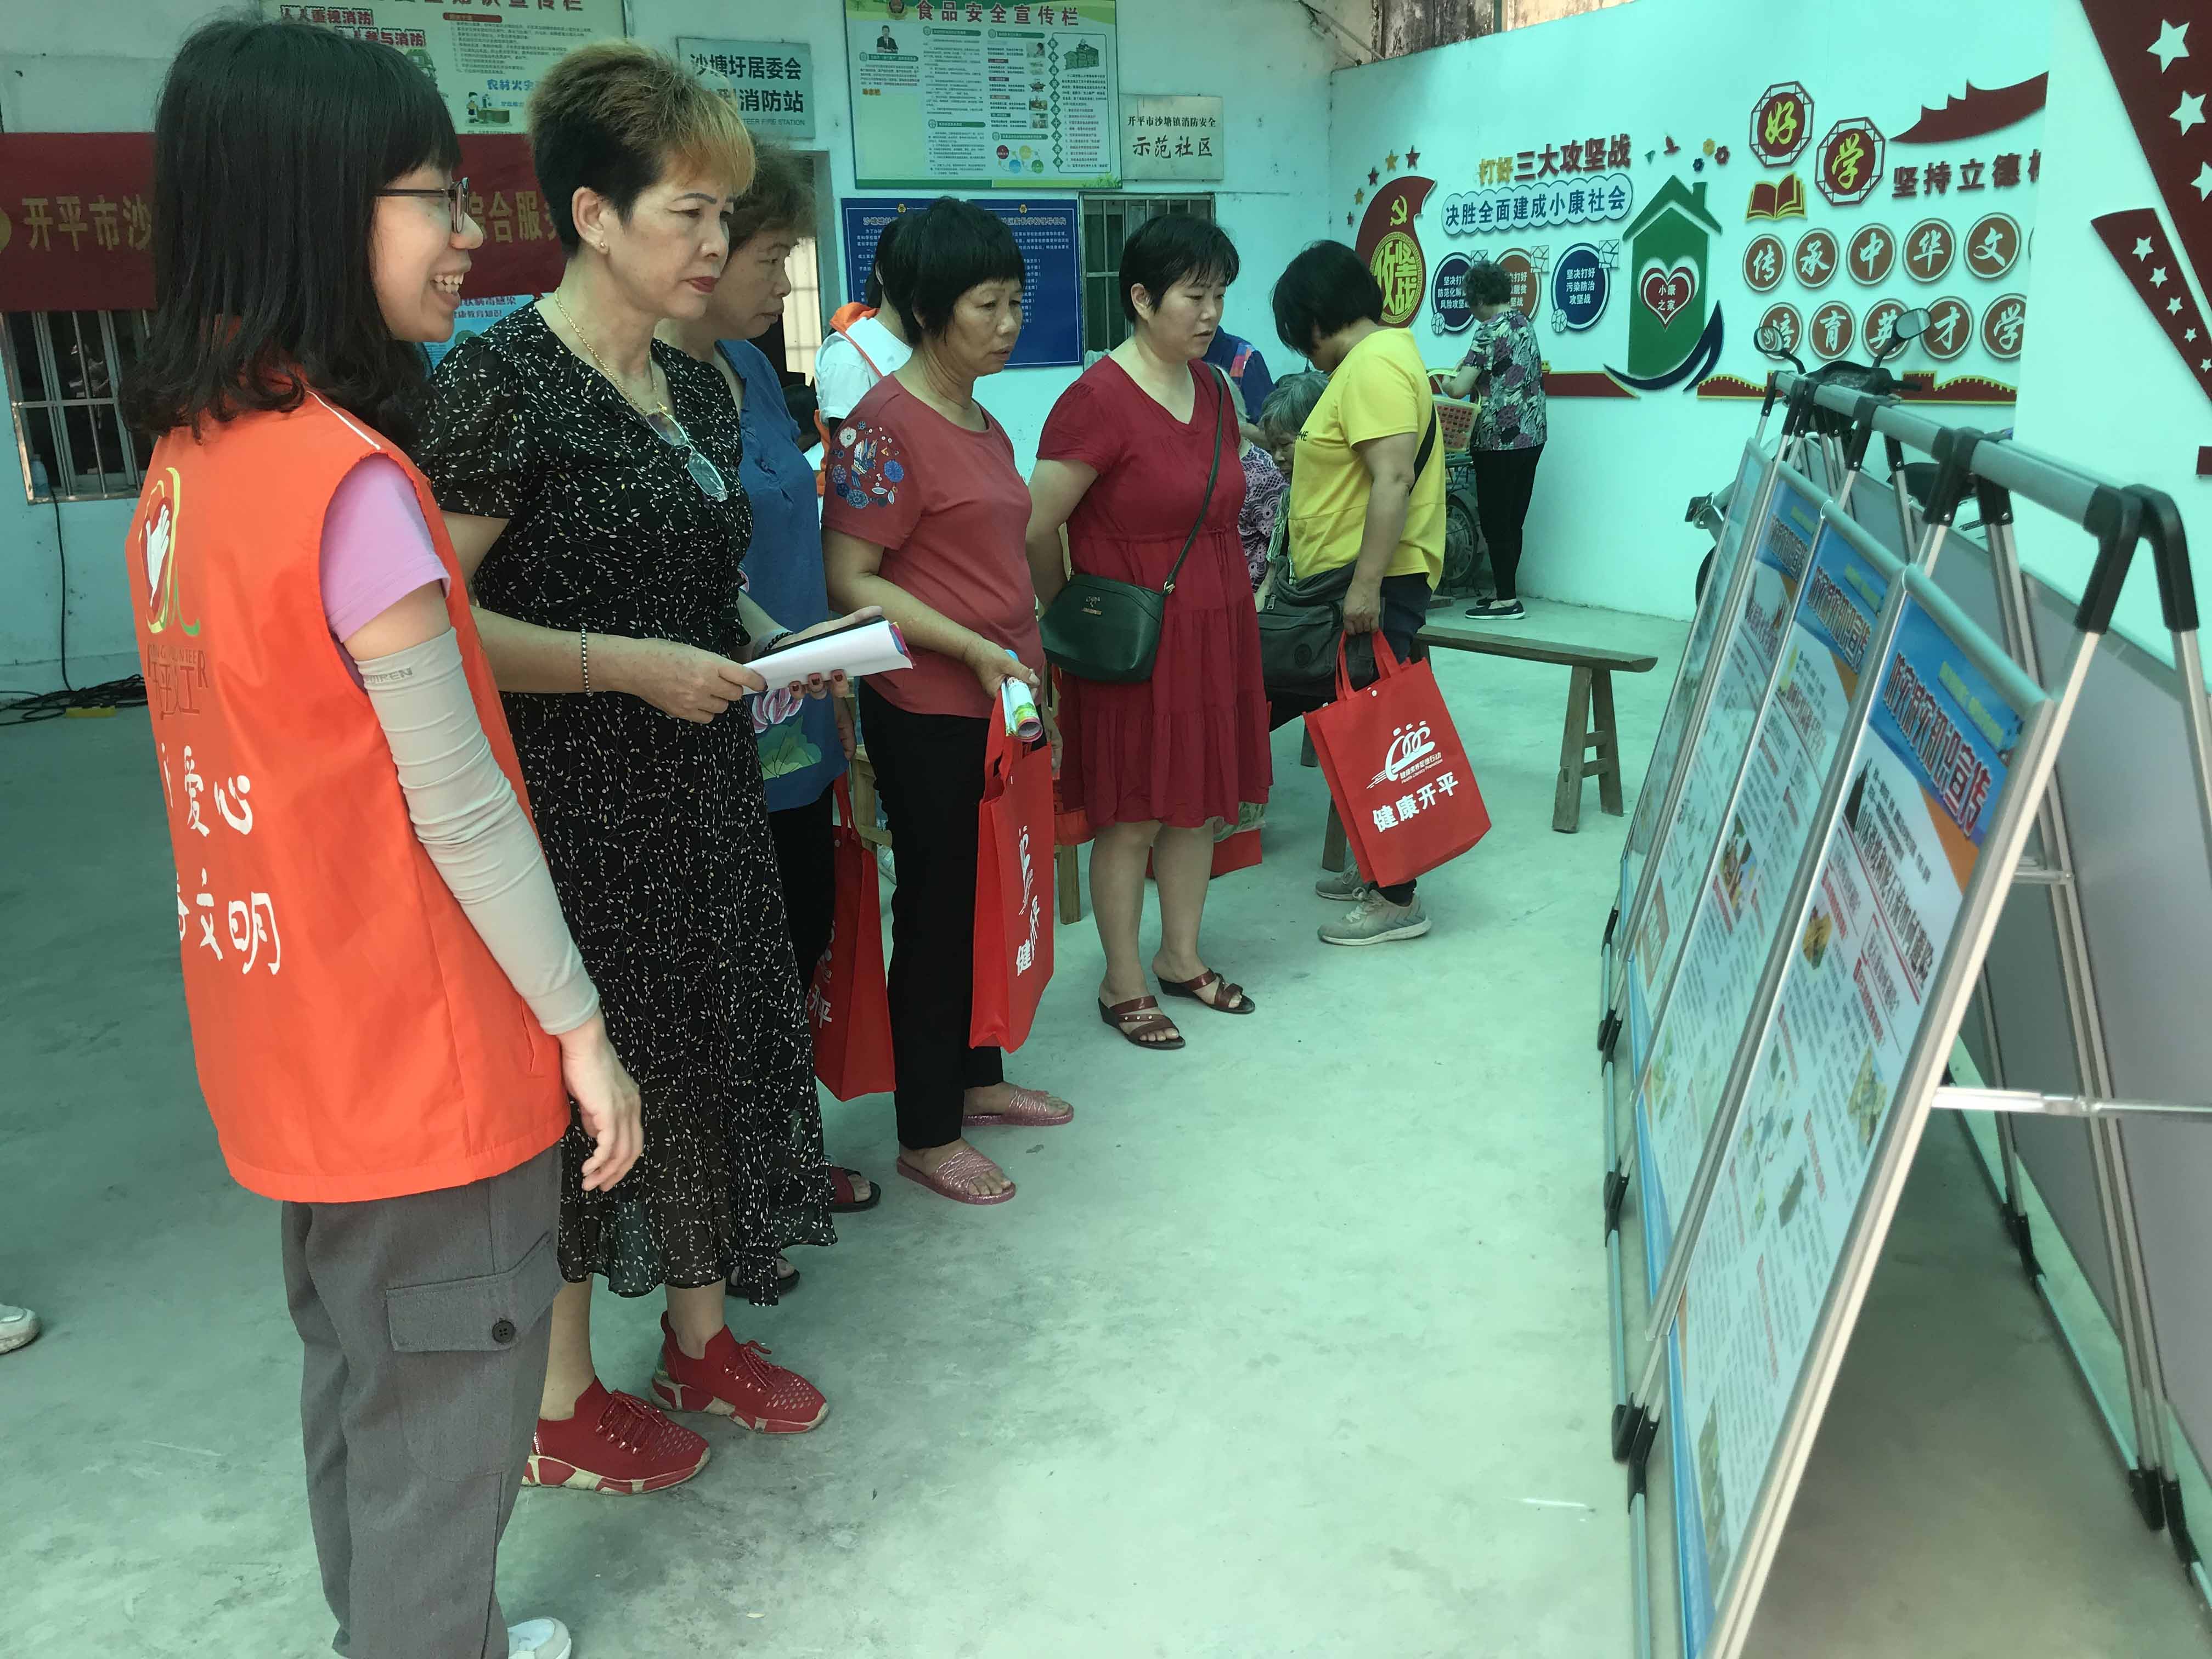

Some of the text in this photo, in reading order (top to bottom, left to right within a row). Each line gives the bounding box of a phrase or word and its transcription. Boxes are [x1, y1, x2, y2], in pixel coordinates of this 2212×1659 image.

[916, 0, 1080, 27] 食品安全宣传栏
[690, 53, 802, 81] 沙塘圩居委会
[1127, 116, 1216, 128] 开平市沙塘镇消防安全
[1764, 100, 1797, 146] 好
[1132, 134, 1213, 159] 示范社区
[1478, 133, 1632, 185] 打好三大攻坚战
[1832, 133, 1864, 189] 学
[1444, 184, 1626, 227] 决胜全面建成小康社会
[21, 194, 153, 252] 开平市沙
[1566, 267, 1595, 280] 坚决打好
[1566, 281, 1595, 292] 污染防治
[1569, 293, 1592, 305] 攻坚战
[1658, 284, 1677, 297] 小康
[1657, 300, 1676, 311] 之家
[1883, 651, 1993, 839] 防灾减灾知识宣传
[1372, 771, 1459, 833] 健康开平
